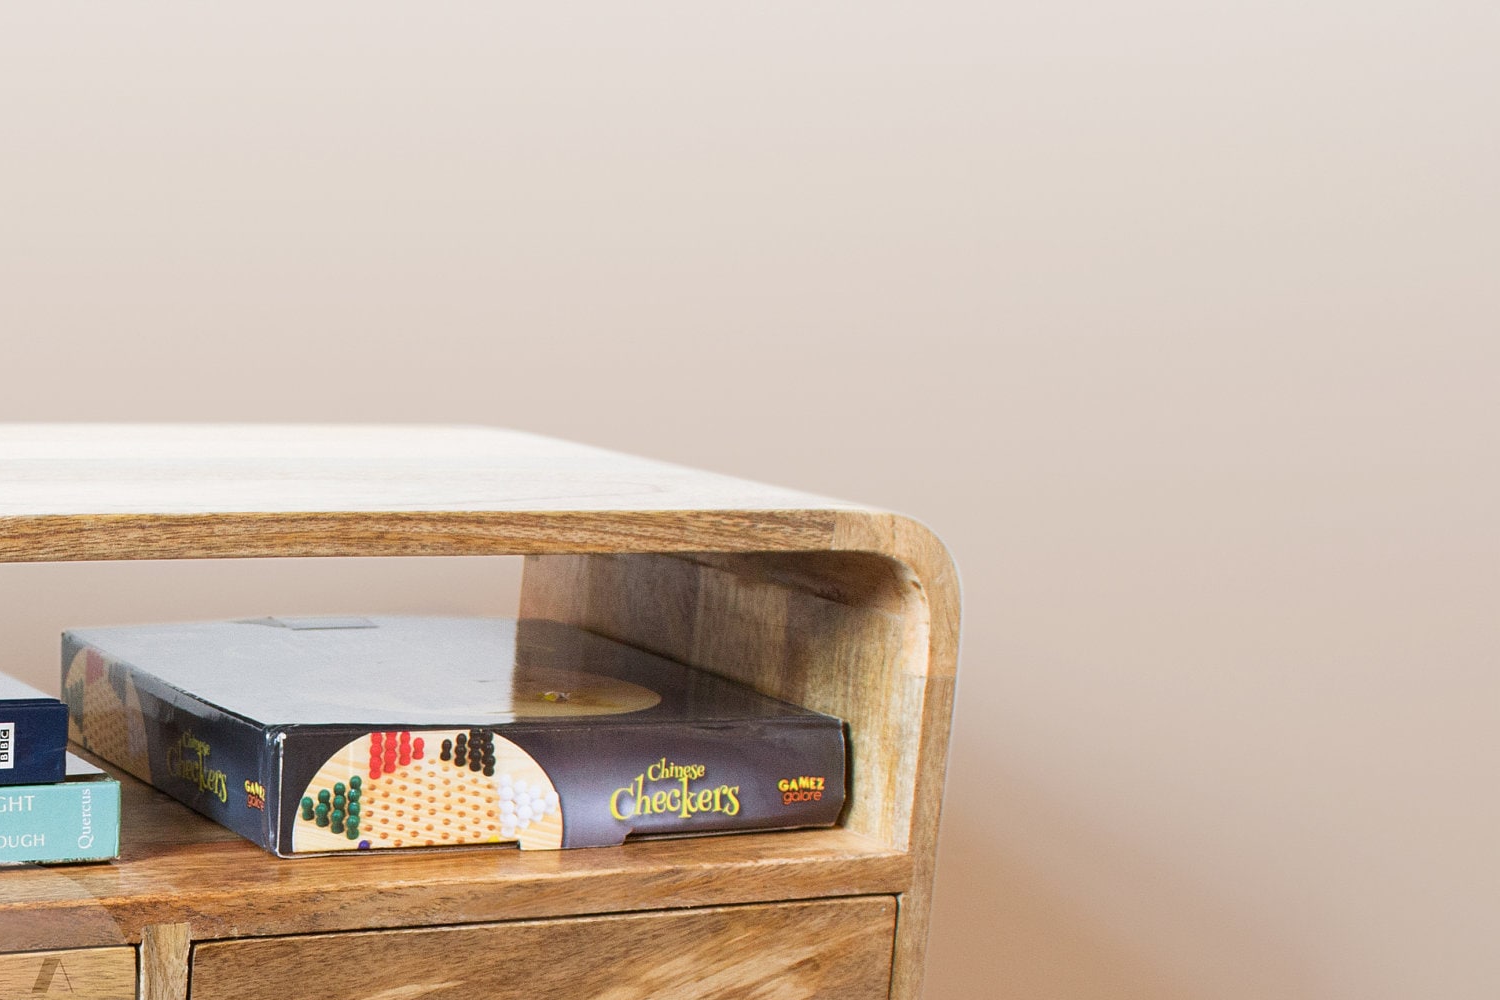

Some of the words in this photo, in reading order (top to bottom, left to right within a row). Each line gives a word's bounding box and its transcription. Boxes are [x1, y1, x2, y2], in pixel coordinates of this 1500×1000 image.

[0, 729, 10, 763] BBC
[647, 757, 706, 781] Chinese
[609, 773, 741, 821] Checkers
[778, 776, 825, 792] GAMEZ
[783, 790, 823, 805] galore
[77, 788, 94, 850] Quercus
